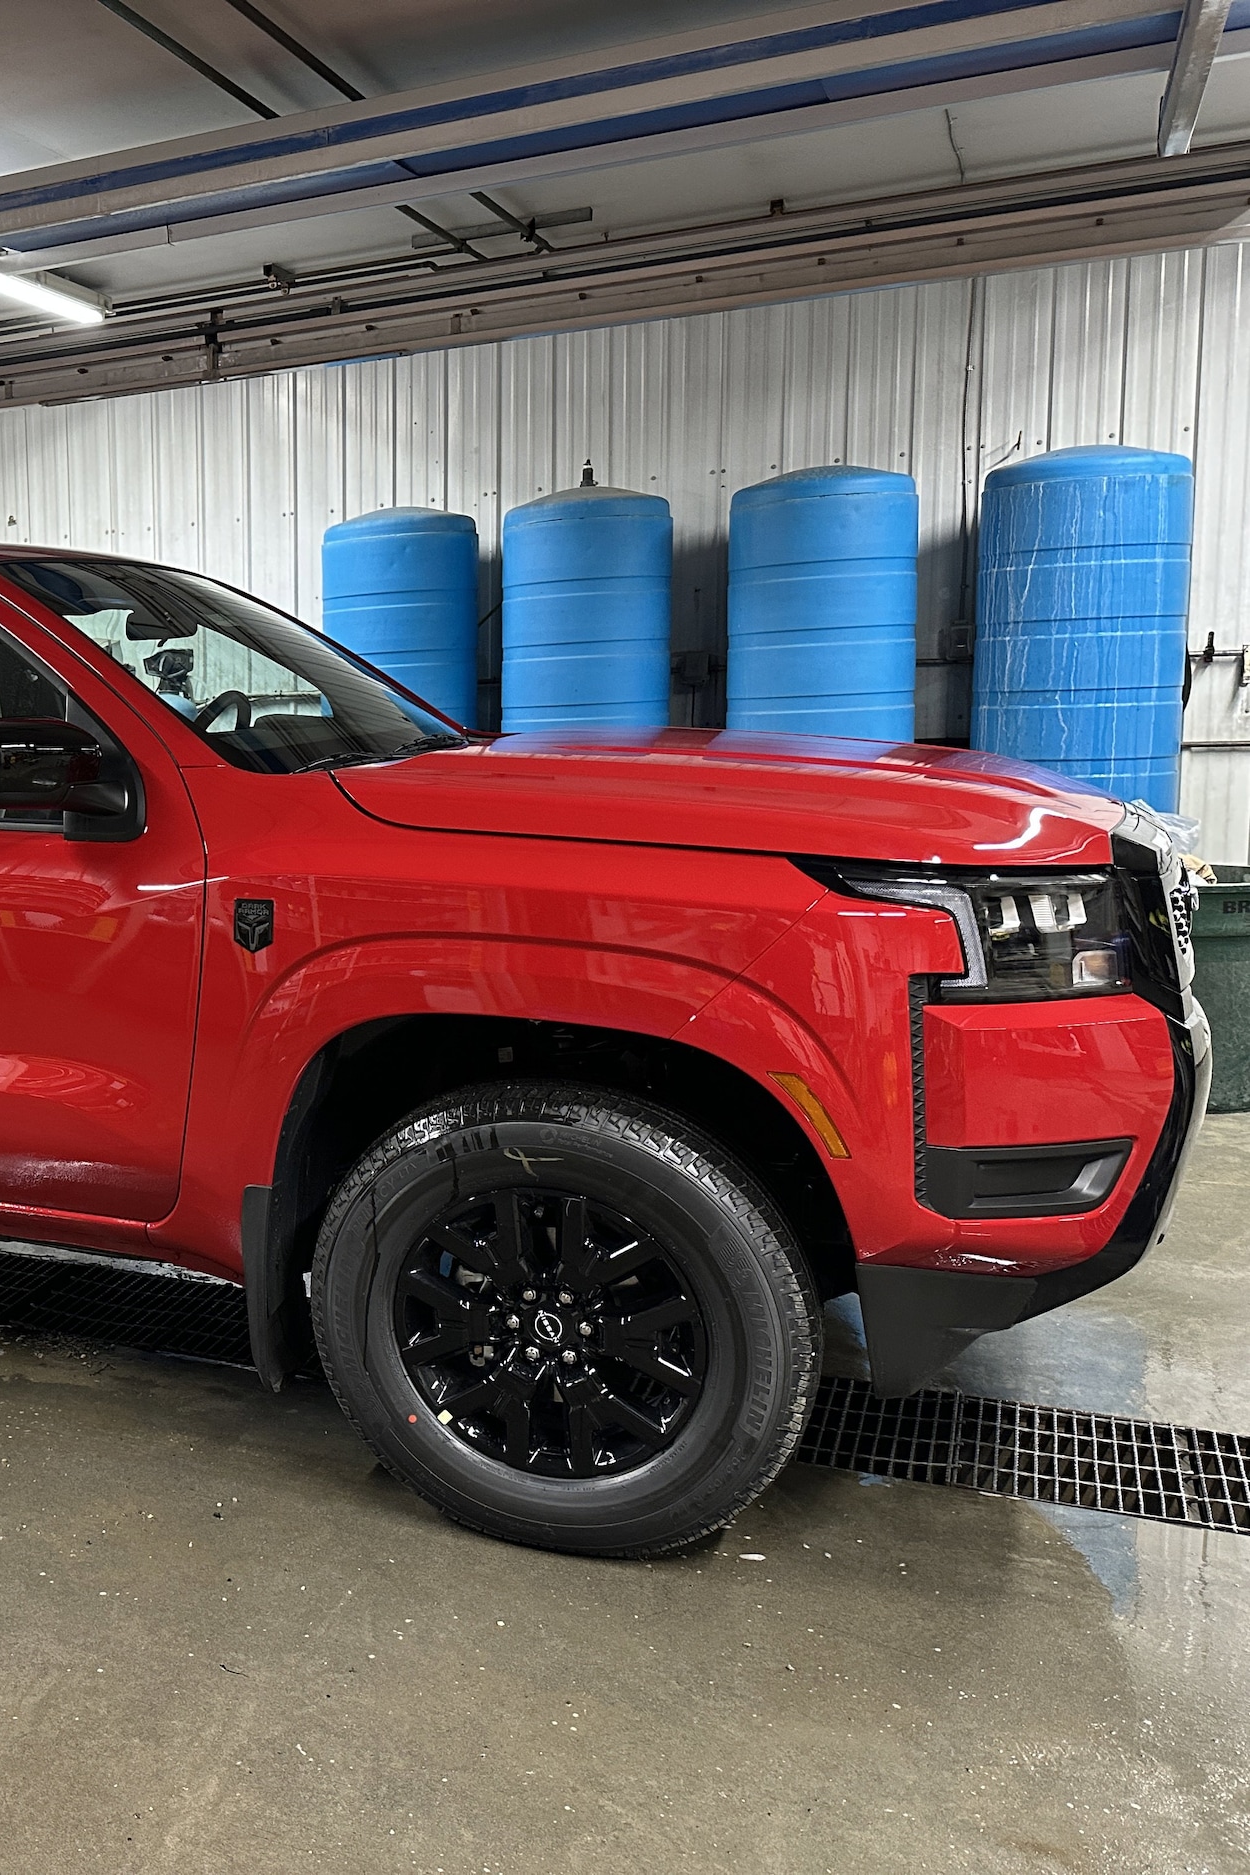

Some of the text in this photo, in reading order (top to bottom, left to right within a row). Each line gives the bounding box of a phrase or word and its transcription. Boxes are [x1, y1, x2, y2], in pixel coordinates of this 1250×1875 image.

[241, 902, 266, 910] DARK
[238, 908, 270, 916] ARMOR
[742, 1290, 773, 1432] MICHELIN
